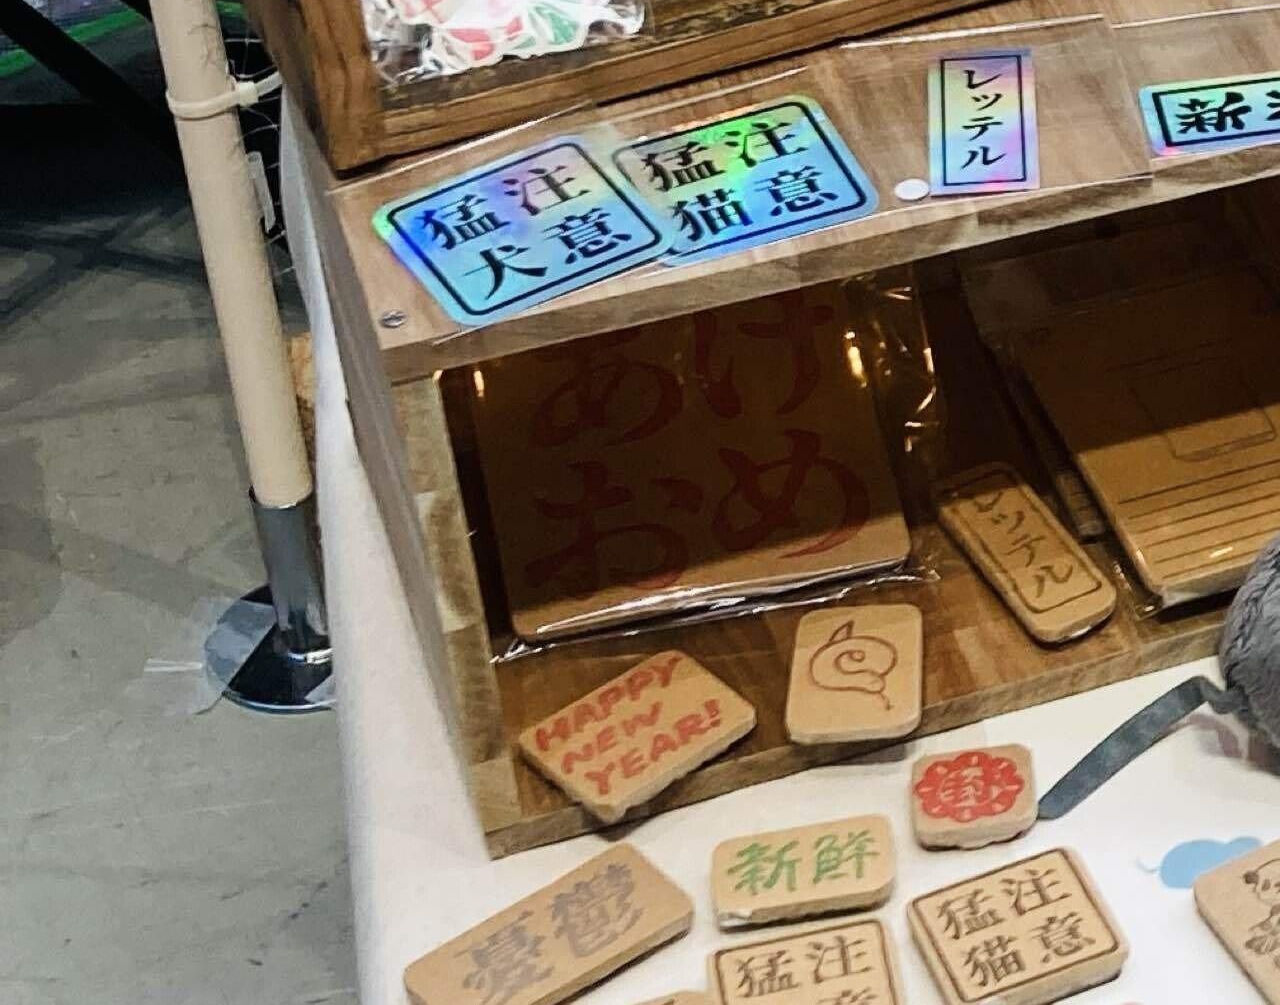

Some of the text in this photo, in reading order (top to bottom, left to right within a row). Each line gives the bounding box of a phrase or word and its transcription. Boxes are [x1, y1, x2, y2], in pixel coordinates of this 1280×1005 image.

[959, 65, 1007, 172] レッテル
[968, 489, 1074, 598] レッテル
[535, 656, 682, 754] HAPPY
[560, 703, 663, 776] NEW
[583, 699, 723, 796] YEAR!
[726, 827, 884, 895] 新鮮
